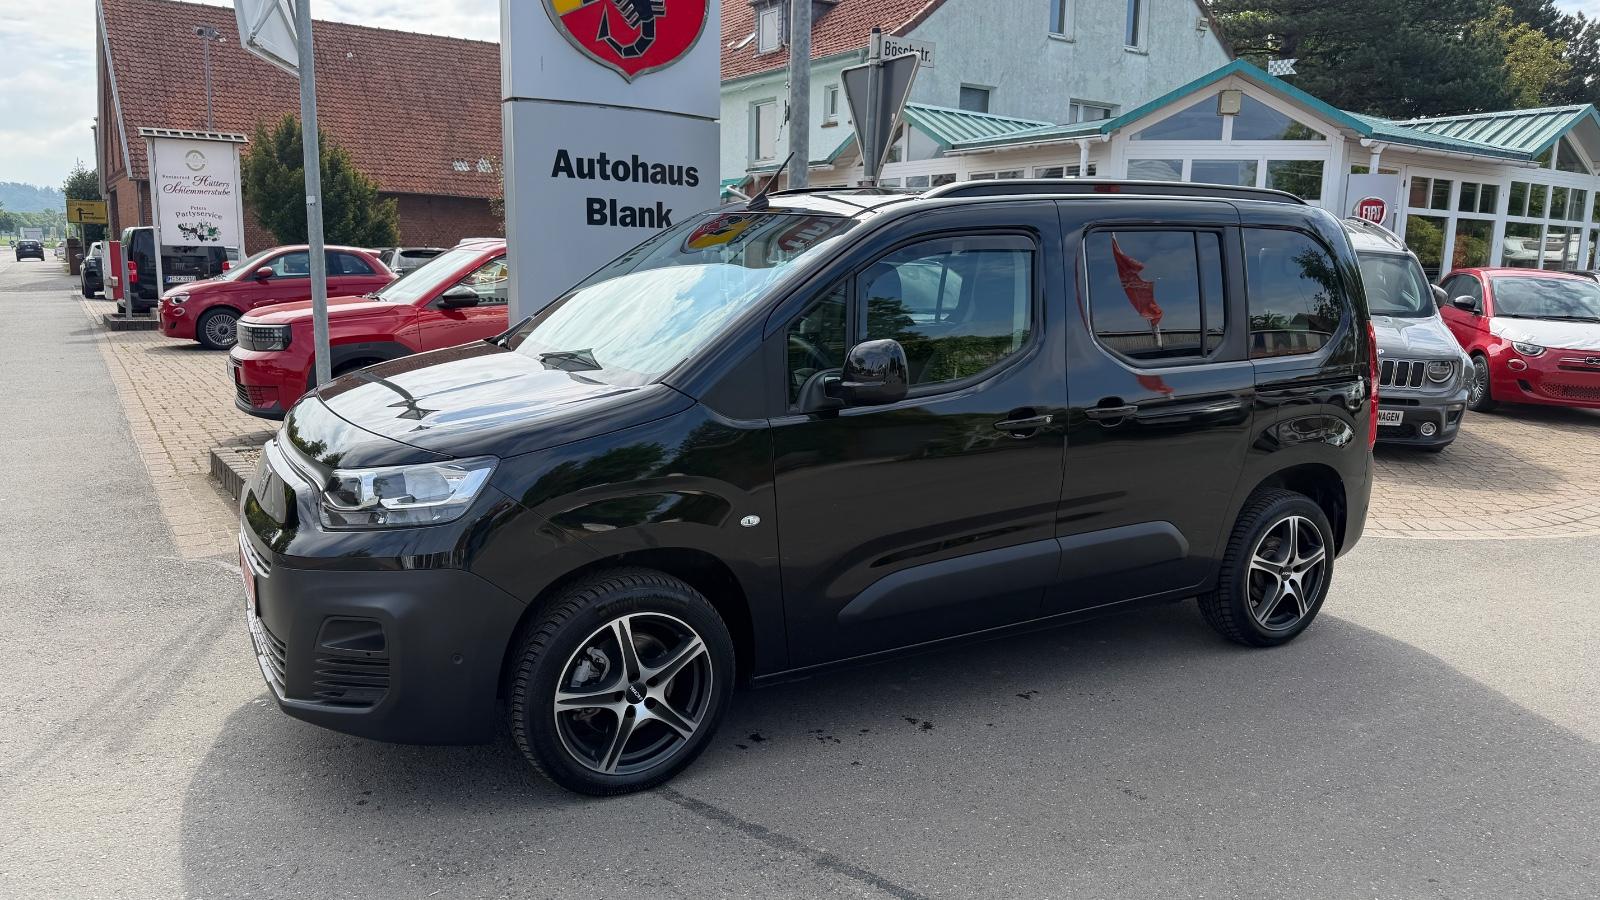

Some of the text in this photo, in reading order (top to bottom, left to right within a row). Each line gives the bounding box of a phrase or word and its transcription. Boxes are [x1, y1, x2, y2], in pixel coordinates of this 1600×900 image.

[884, 40, 931, 62] Böschtr.
[551, 149, 699, 187] Autohaus
[163, 181, 231, 195] Schlemmerstube
[175, 210, 222, 219] Partyservice
[586, 197, 672, 228] Blank
[1363, 205, 1383, 220] FIAT
